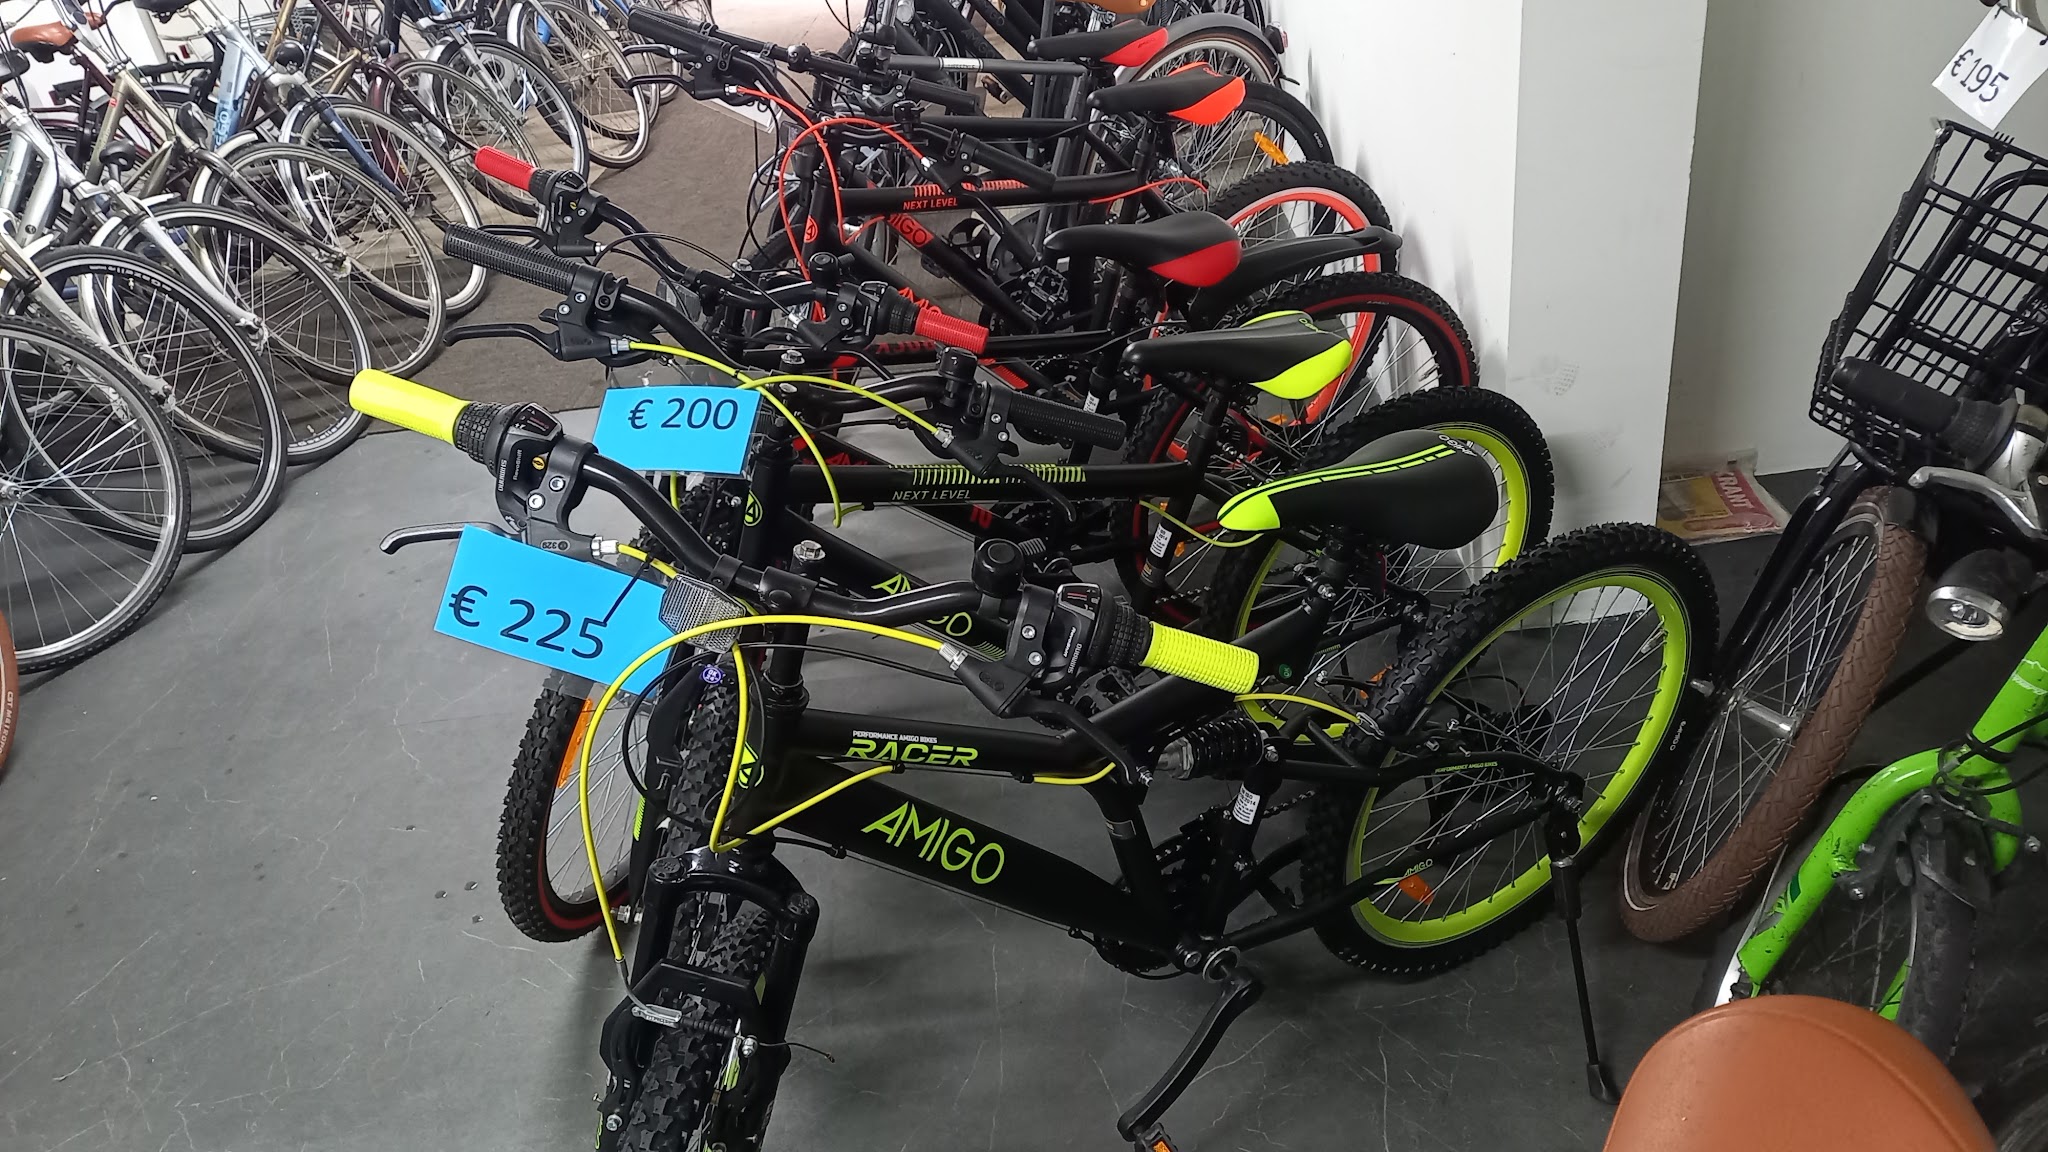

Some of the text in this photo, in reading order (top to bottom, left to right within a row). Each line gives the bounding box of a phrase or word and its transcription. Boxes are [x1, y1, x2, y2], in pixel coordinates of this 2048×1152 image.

[1951, 48, 2009, 102] €195
[903, 197, 958, 210] NEXT LEVEL
[628, 397, 739, 430] € 200
[498, 459, 507, 492] SHIMANO
[892, 489, 971, 501] NEXT LEVEL
[448, 585, 604, 660] € 225
[1067, 643, 1083, 674] SHIMANO
[845, 738, 979, 767] RACER
[852, 730, 938, 744] PERFORMANCE AMIGO BIKES
[860, 801, 1005, 885] AMIGO
[1404, 858, 1433, 877] AMIGO
